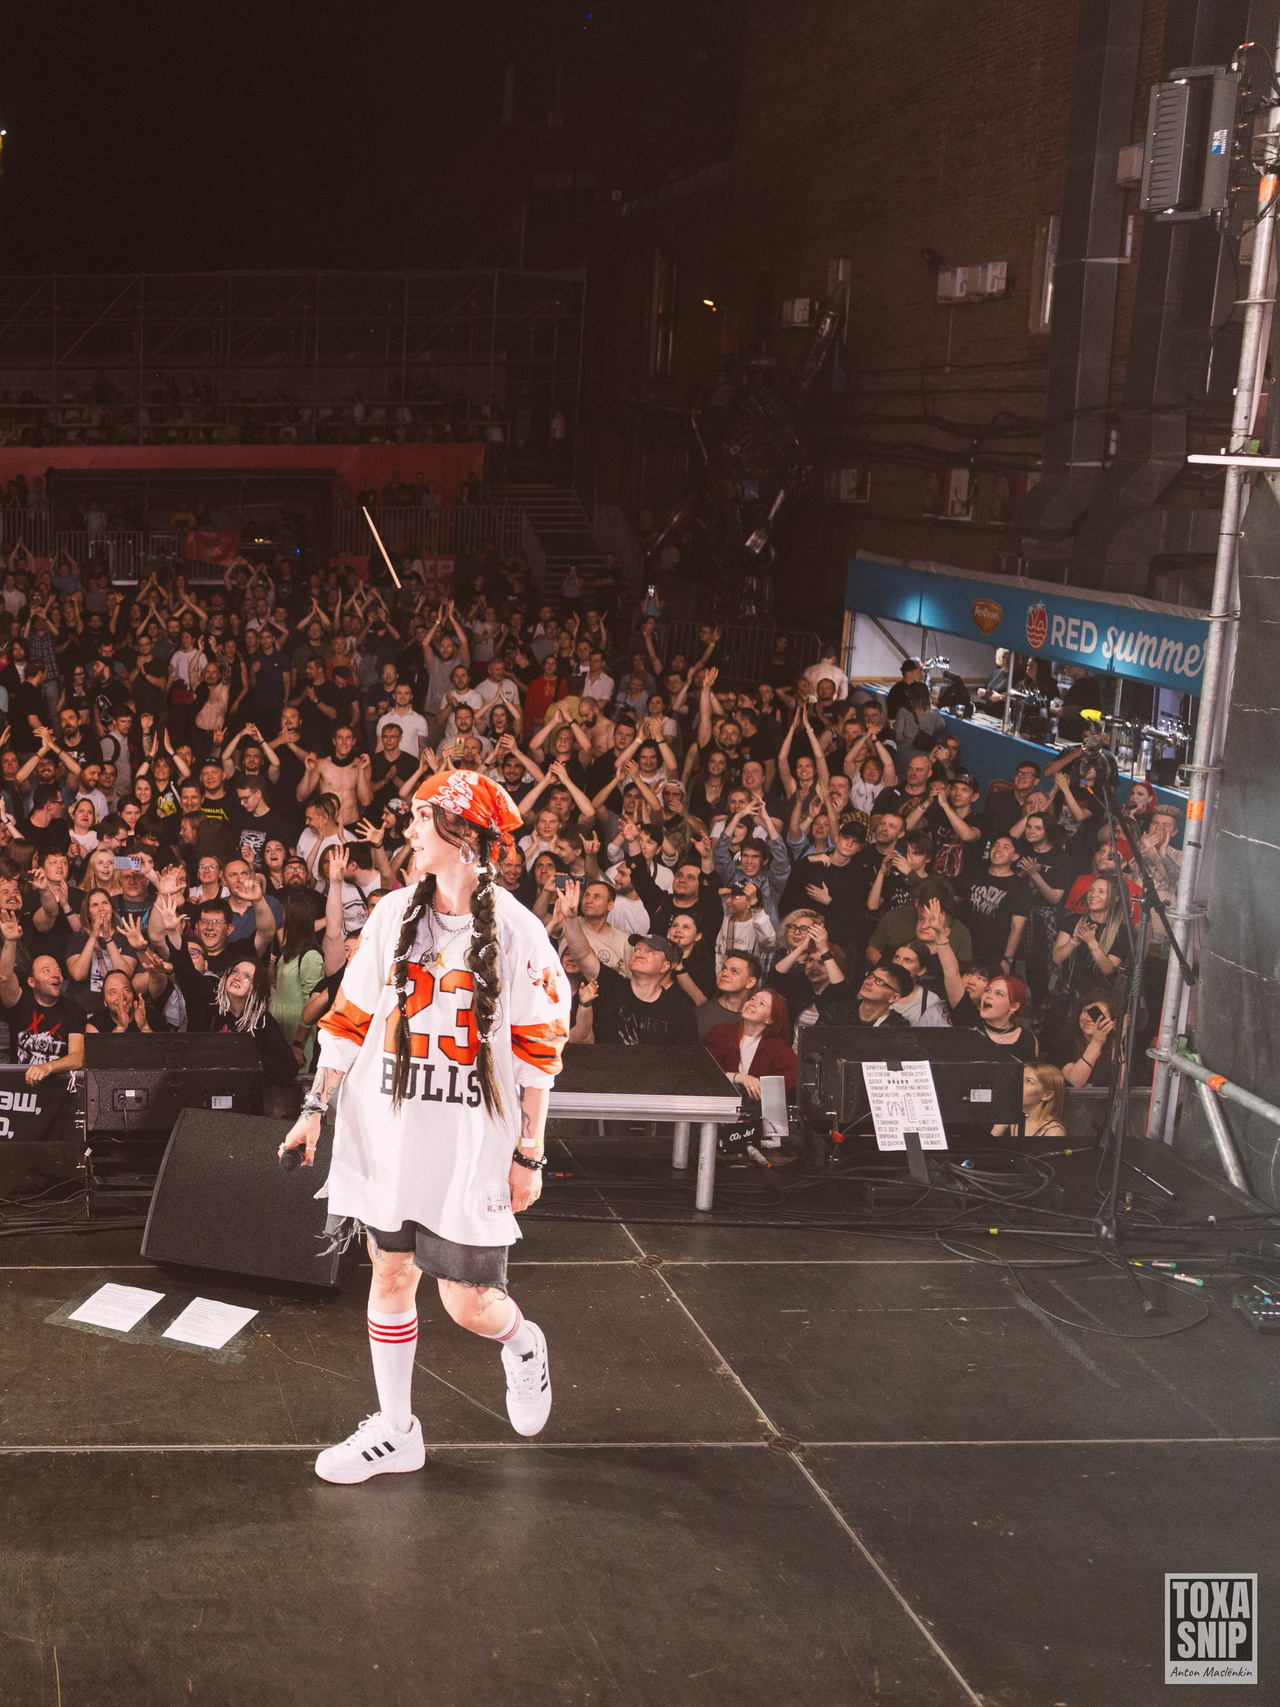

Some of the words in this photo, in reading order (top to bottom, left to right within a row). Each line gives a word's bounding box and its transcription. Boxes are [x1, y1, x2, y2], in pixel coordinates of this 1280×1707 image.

[1051, 614, 1098, 654] RED
[384, 960, 482, 1066] 23
[380, 1056, 482, 1108] BULLS
